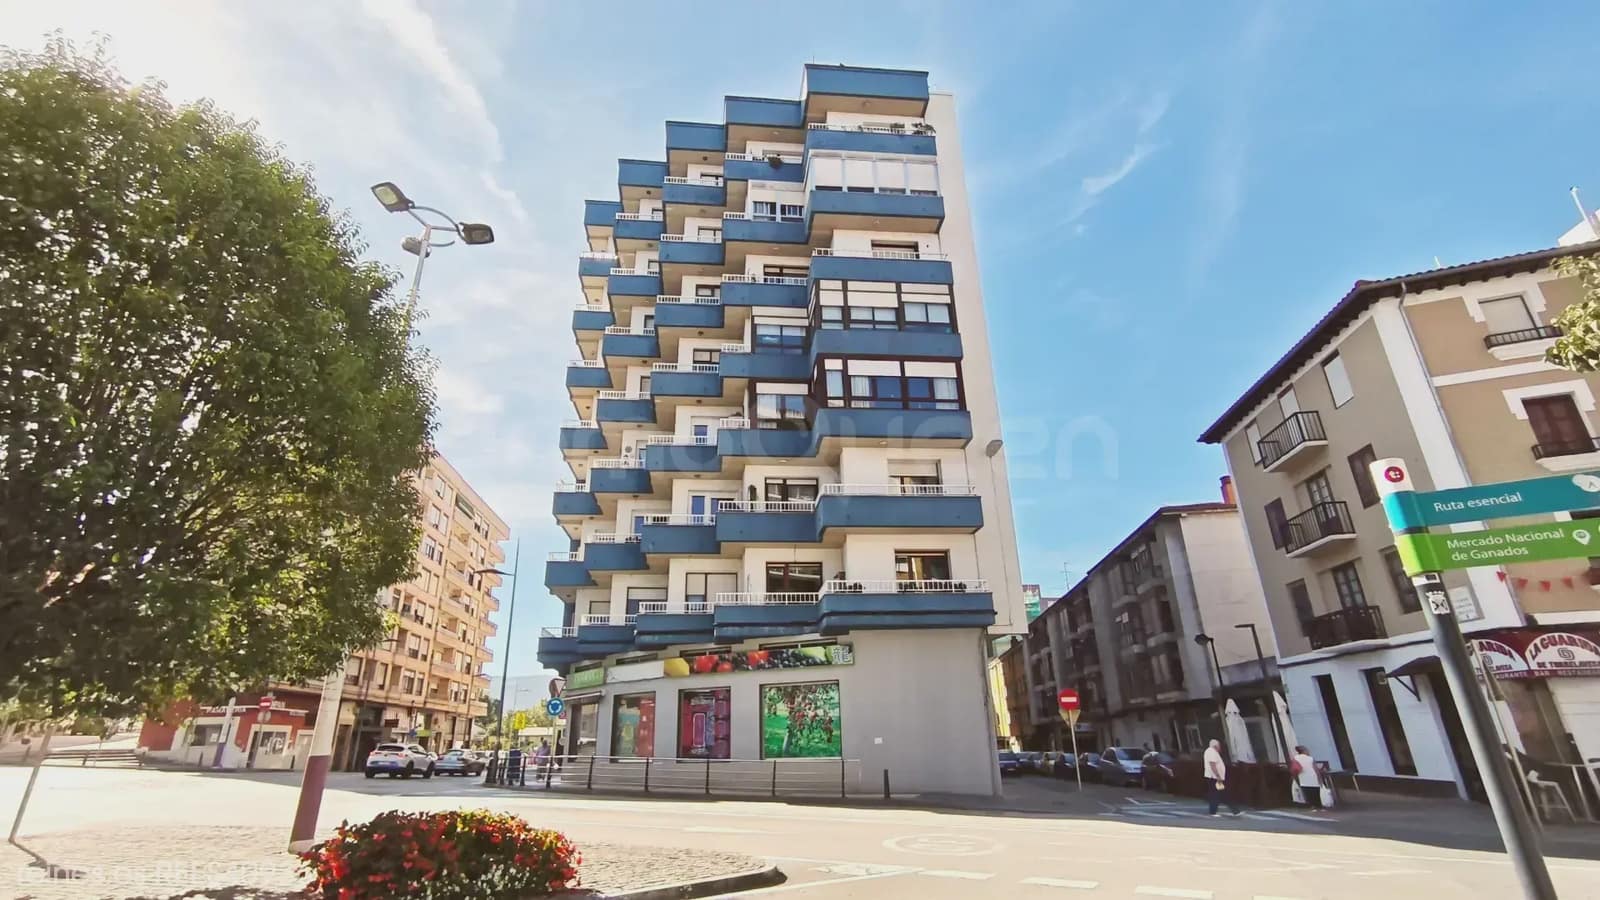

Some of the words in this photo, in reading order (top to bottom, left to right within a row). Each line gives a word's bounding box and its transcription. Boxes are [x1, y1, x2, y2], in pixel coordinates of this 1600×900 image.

[1433, 501, 1465, 513] Ruta
[1467, 492, 1522, 507] esencial
[1447, 534, 1503, 549] Mercado
[1505, 528, 1565, 544] Nacional
[1451, 550, 1469, 562] de
[1470, 546, 1528, 560] Ganados
